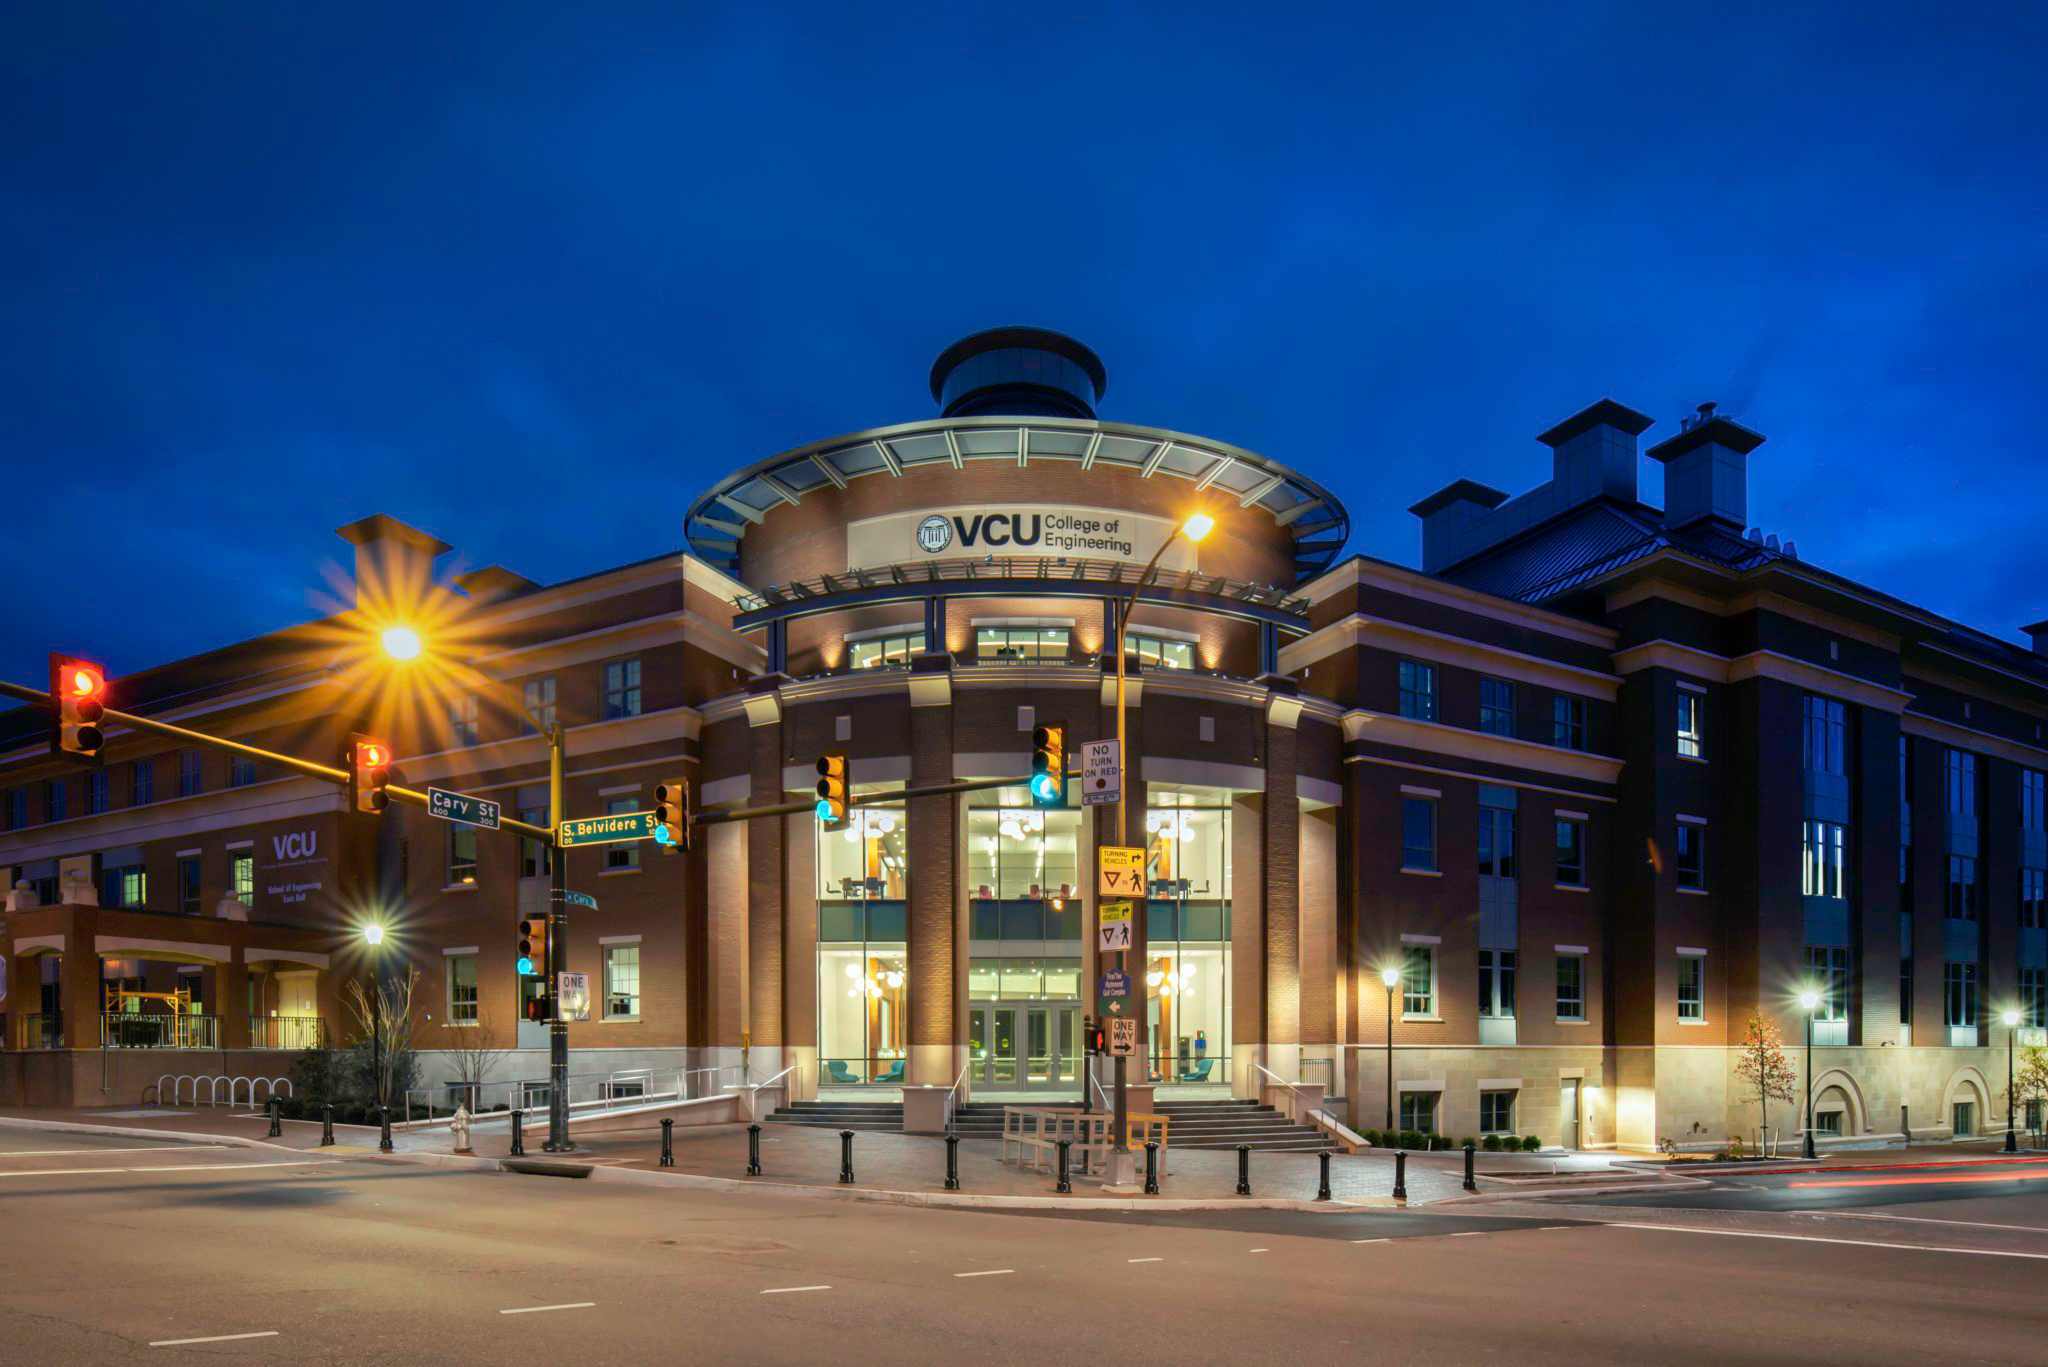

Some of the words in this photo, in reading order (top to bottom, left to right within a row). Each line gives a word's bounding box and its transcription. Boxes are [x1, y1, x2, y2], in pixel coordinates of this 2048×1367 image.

[1045, 514, 1101, 534] College
[1105, 519, 1120, 533] of
[952, 513, 1041, 548] VCU
[1045, 532, 1132, 555] Engineering
[1093, 744, 1109, 756] NO
[1090, 757, 1112, 767] TURN
[1085, 769, 1096, 778] ON
[1100, 767, 1118, 776] RED
[433, 793, 469, 815] Cary
[479, 804, 495, 818] St
[433, 807, 449, 817] 600
[480, 817, 494, 826] 300
[564, 824, 575, 837] S.
[577, 817, 637, 836] Belvidere
[272, 831, 316, 860] VCU
[564, 837, 573, 845] 00
[564, 977, 584, 988] ONE
[1114, 1021, 1133, 1031] ONE
[1113, 1033, 1133, 1041] WAY
